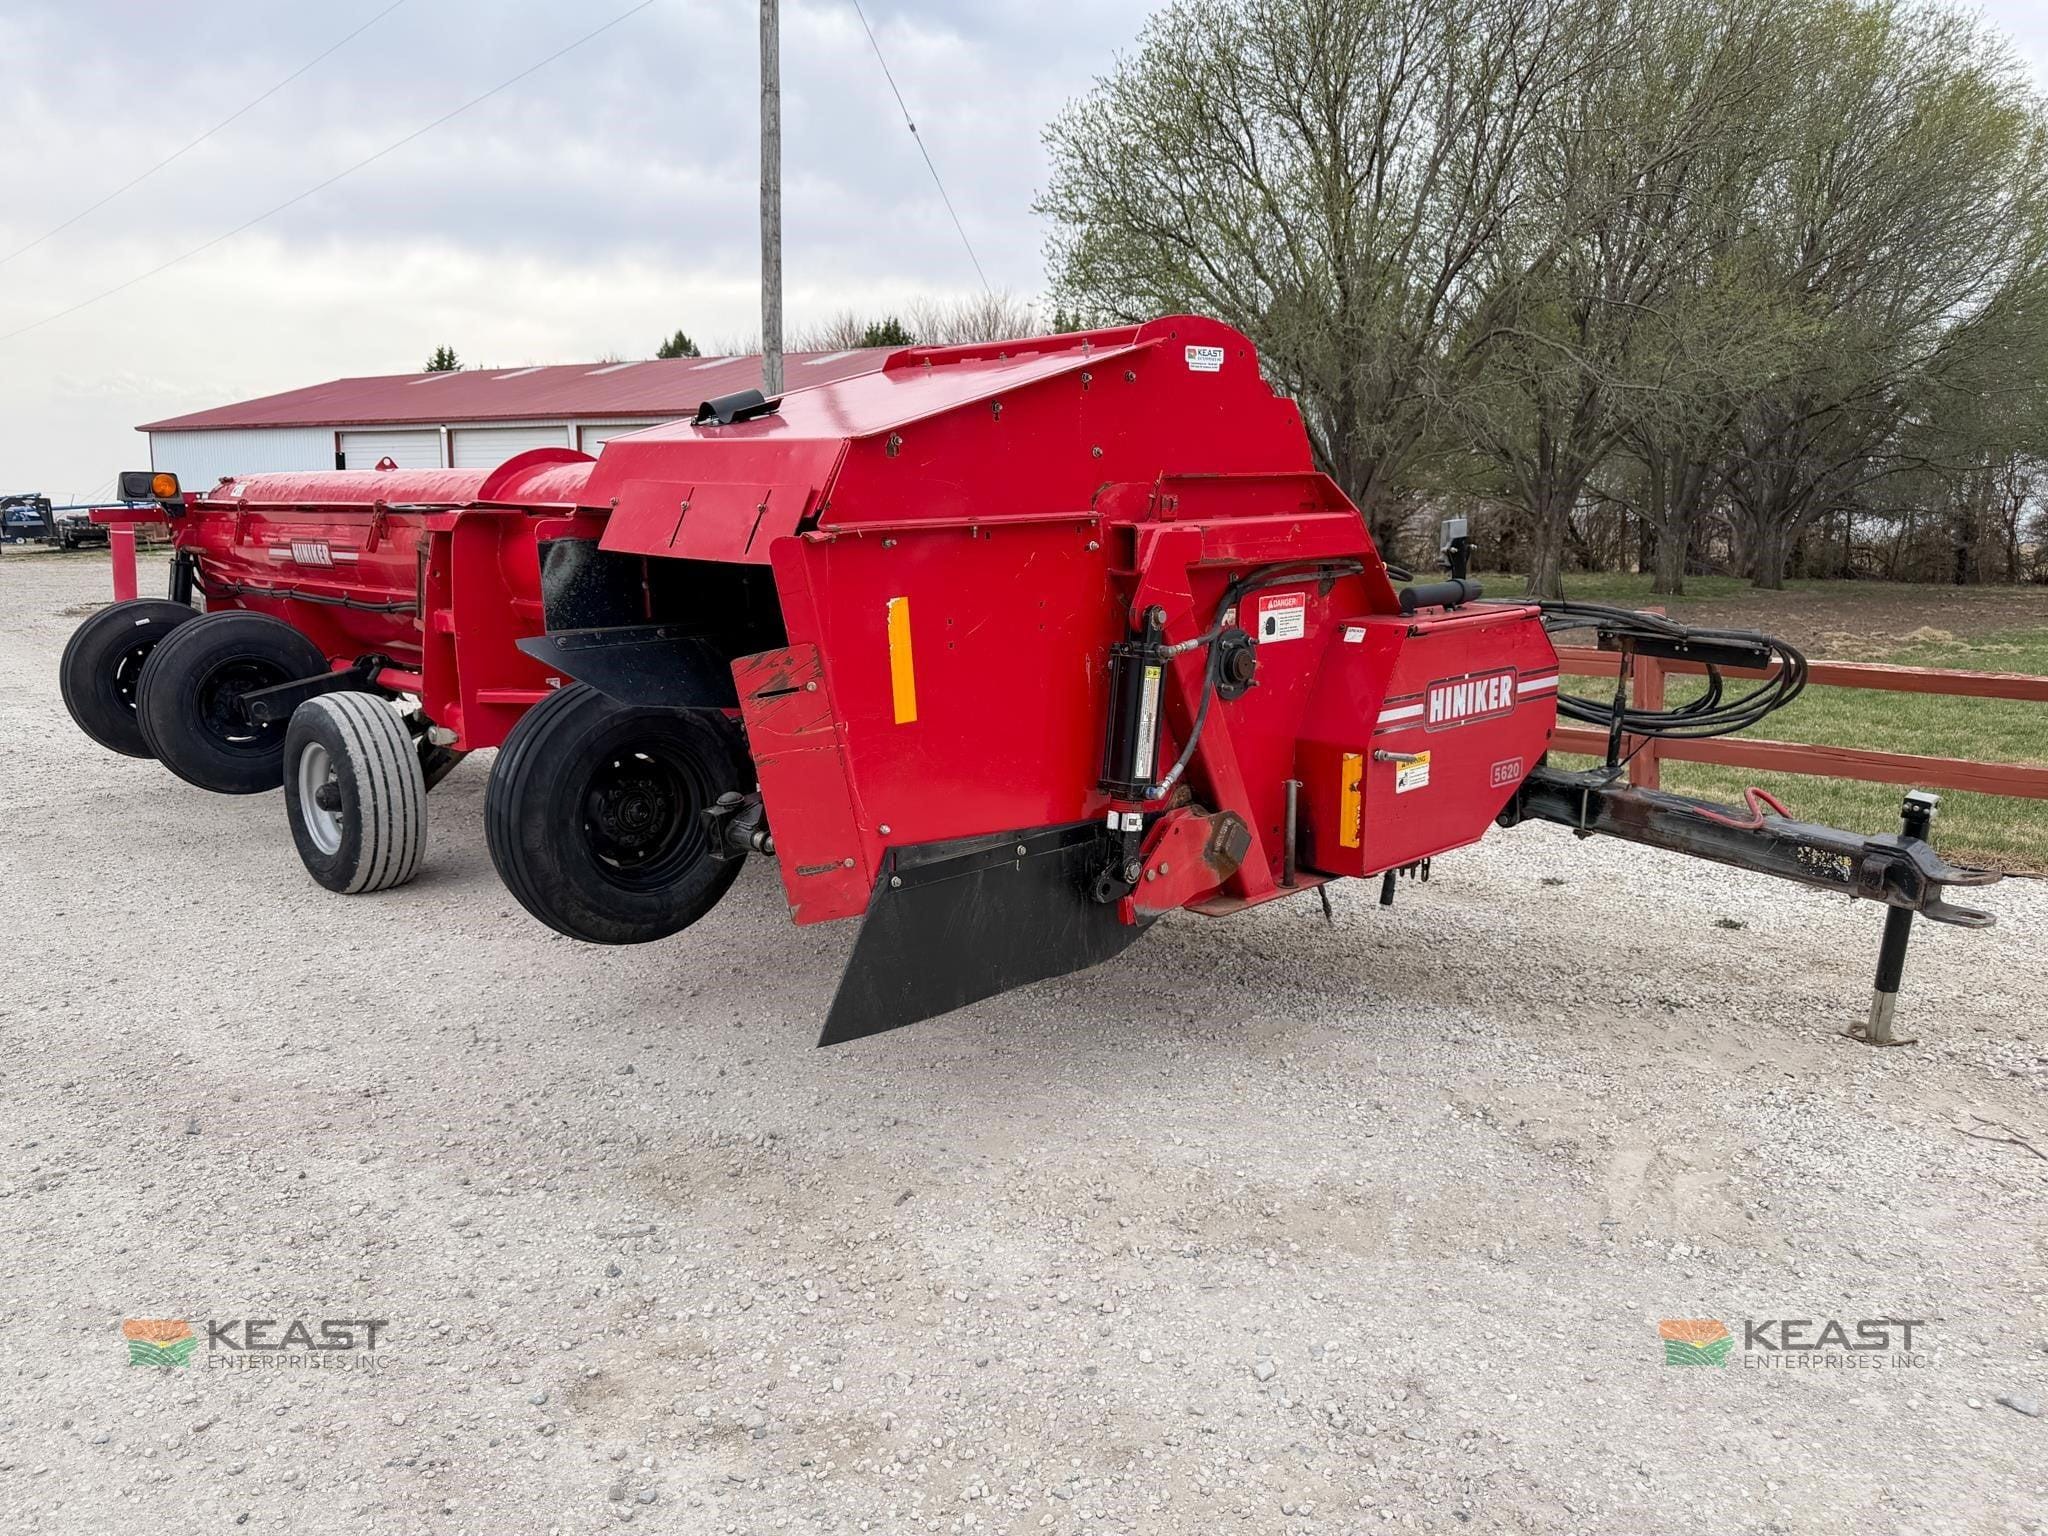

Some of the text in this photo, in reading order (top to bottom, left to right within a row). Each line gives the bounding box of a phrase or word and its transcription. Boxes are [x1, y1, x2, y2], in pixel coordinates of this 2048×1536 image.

[1198, 349, 1222, 357] KEAST
[292, 543, 333, 565] HINIKER
[1273, 597, 1296, 607] DANGER
[1429, 675, 1513, 723] HINIKER
[1494, 763, 1519, 783] 5620
